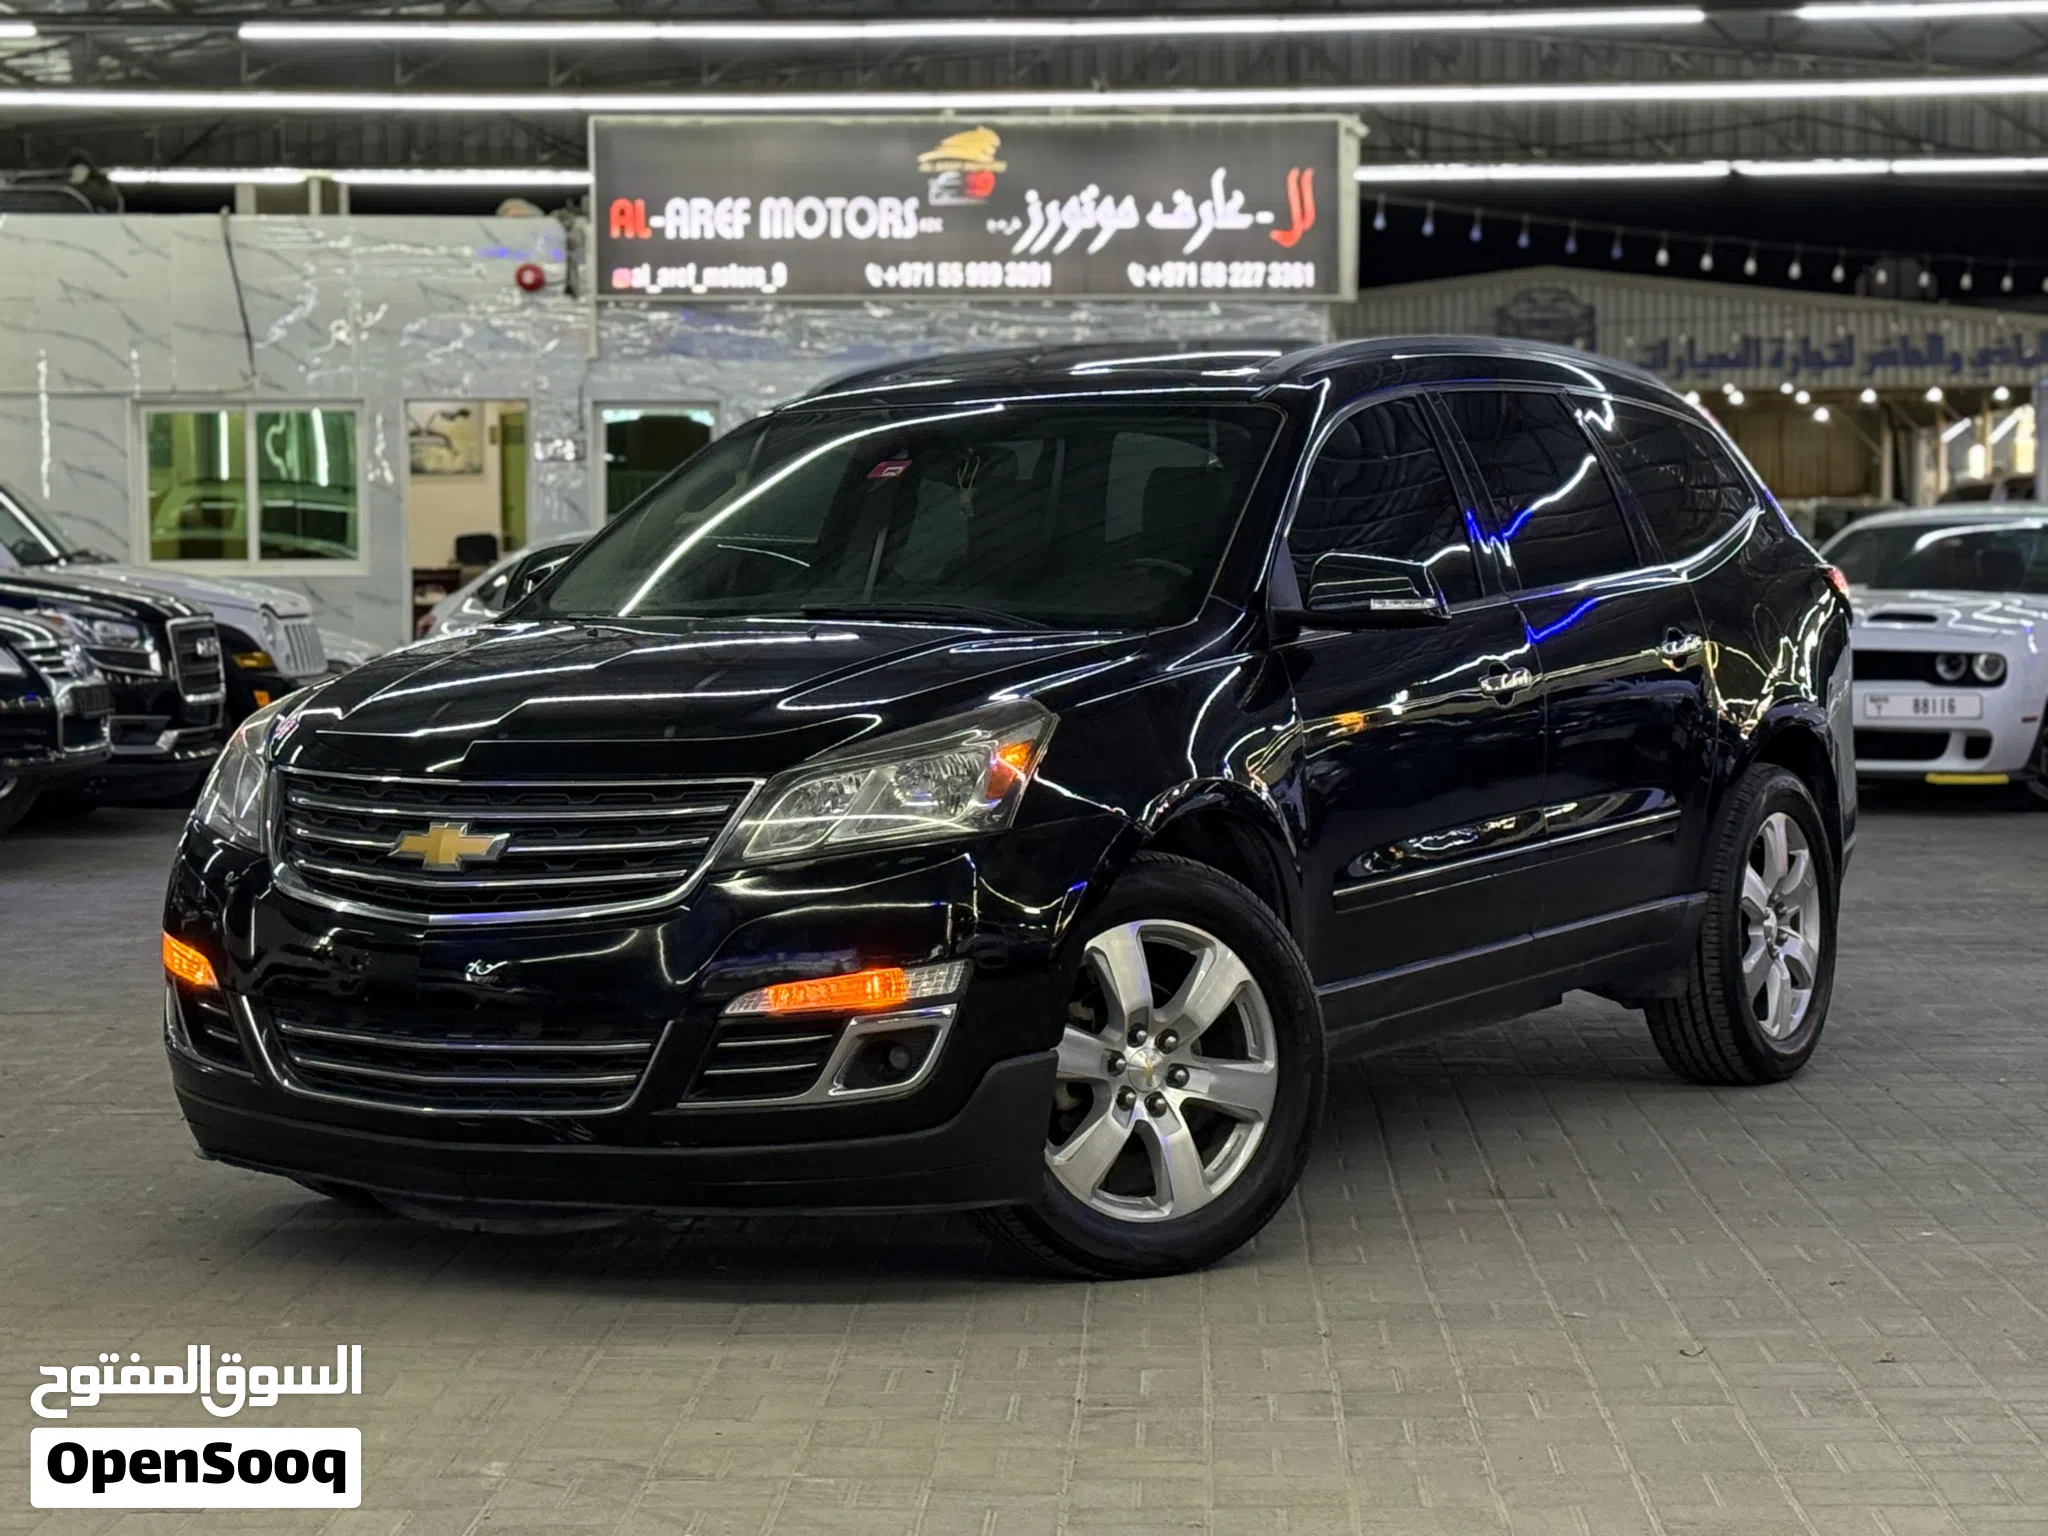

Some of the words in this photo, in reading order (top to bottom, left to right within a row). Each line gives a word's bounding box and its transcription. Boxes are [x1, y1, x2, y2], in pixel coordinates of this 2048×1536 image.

[609, 197, 751, 239] AL-AREF
[759, 196, 919, 239] MOTORS
[1228, 261, 1266, 288] 227
